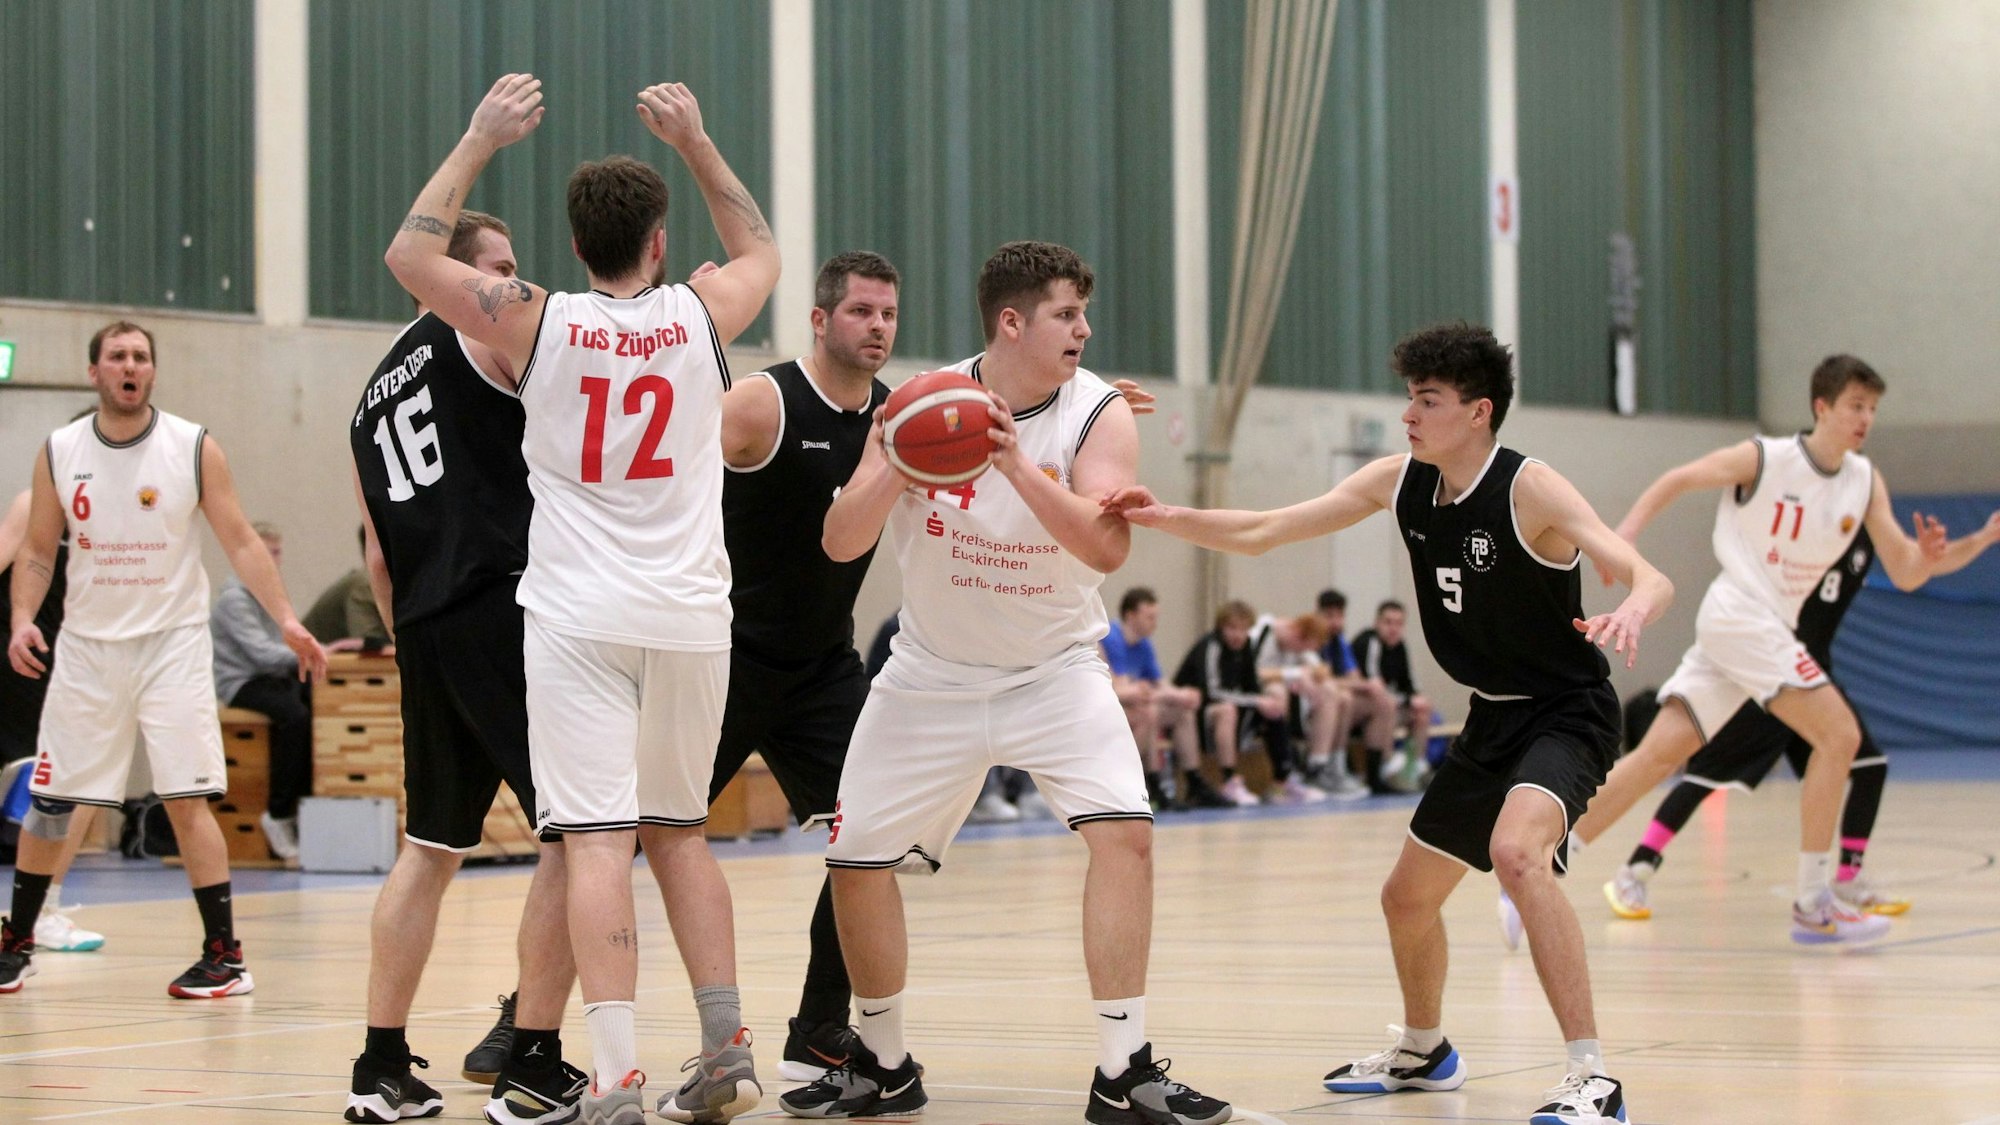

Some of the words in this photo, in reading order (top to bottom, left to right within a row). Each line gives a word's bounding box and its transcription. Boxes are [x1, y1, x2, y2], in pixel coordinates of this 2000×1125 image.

[567, 323, 610, 350] TuS
[615, 321, 688, 361] Züpich
[373, 384, 445, 502] 16
[579, 374, 674, 483] 12
[801, 440, 831, 451] SPALDING
[72, 482, 91, 522] 6
[1770, 501, 1804, 541] 11
[951, 529, 1060, 555] Kreissparkasse
[951, 546, 1028, 571] Euskirchen
[951, 575, 972, 588] Gut
[994, 583, 1017, 596] den
[1020, 583, 1056, 598] Sport.
[1435, 567, 1463, 614] 5
[1819, 570, 1842, 603] 8
